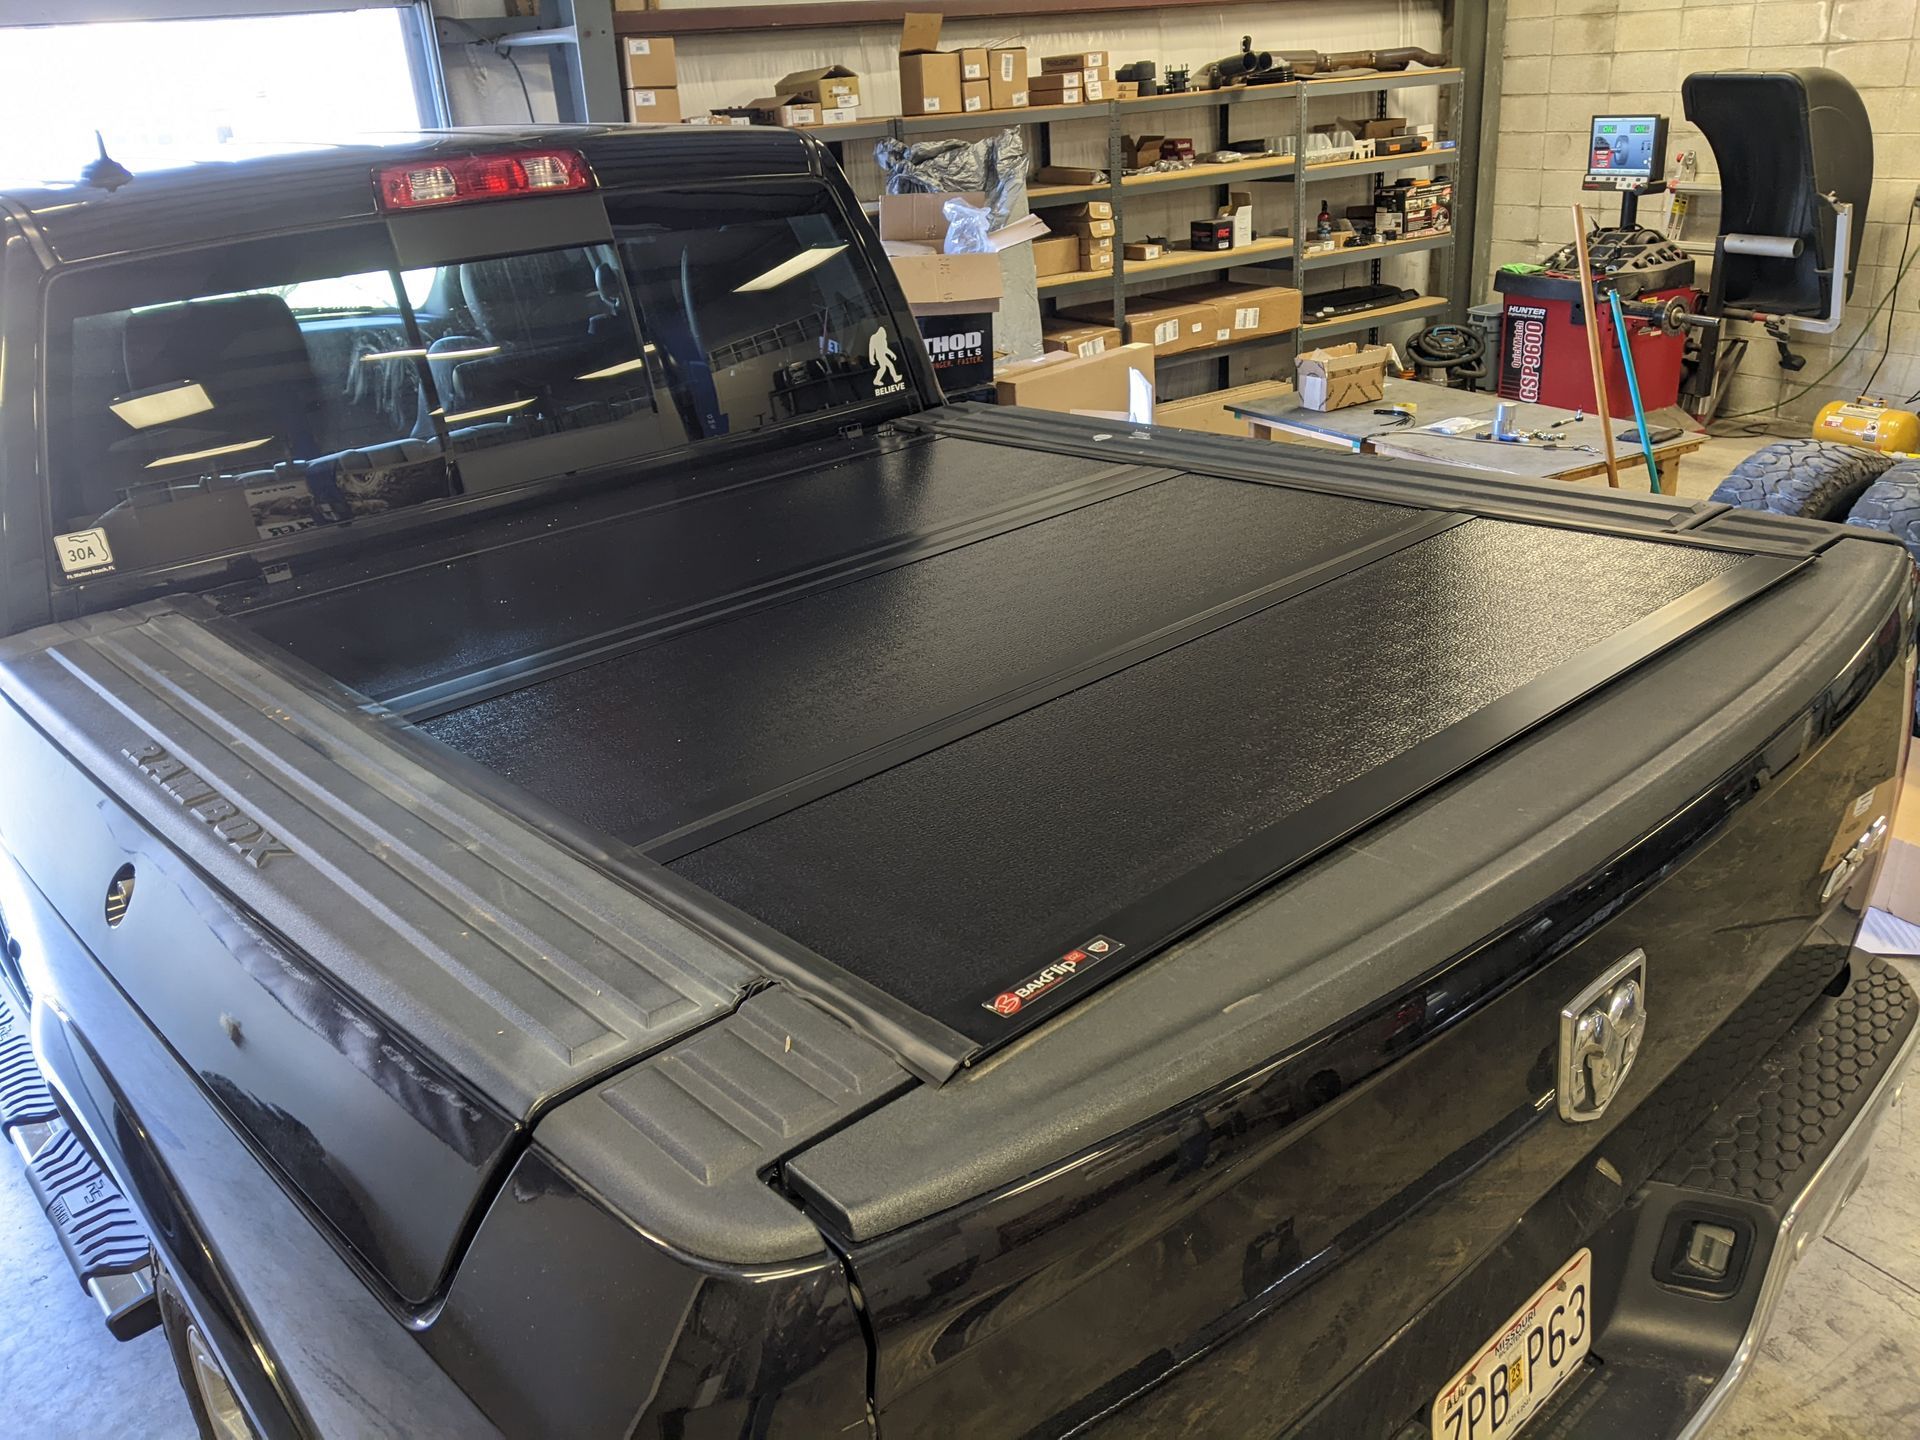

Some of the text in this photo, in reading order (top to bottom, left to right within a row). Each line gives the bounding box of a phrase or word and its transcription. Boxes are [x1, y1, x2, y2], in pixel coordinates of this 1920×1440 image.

[1508, 305, 1547, 316] HUNTER
[922, 331, 982, 355] THOD
[1511, 320, 1524, 369] QuickMatch
[1519, 321, 1544, 403] GSP9600
[874, 382, 906, 397] BELIEVE
[67, 545, 96, 563] 30A
[120, 745, 296, 869] RAMBOX
[1014, 960, 1078, 998] BAKFlip
[1494, 1307, 1537, 1356] MISSOURI
[1444, 1284, 1585, 1440] 7PB P63
[1511, 1363, 1521, 1383] 23
